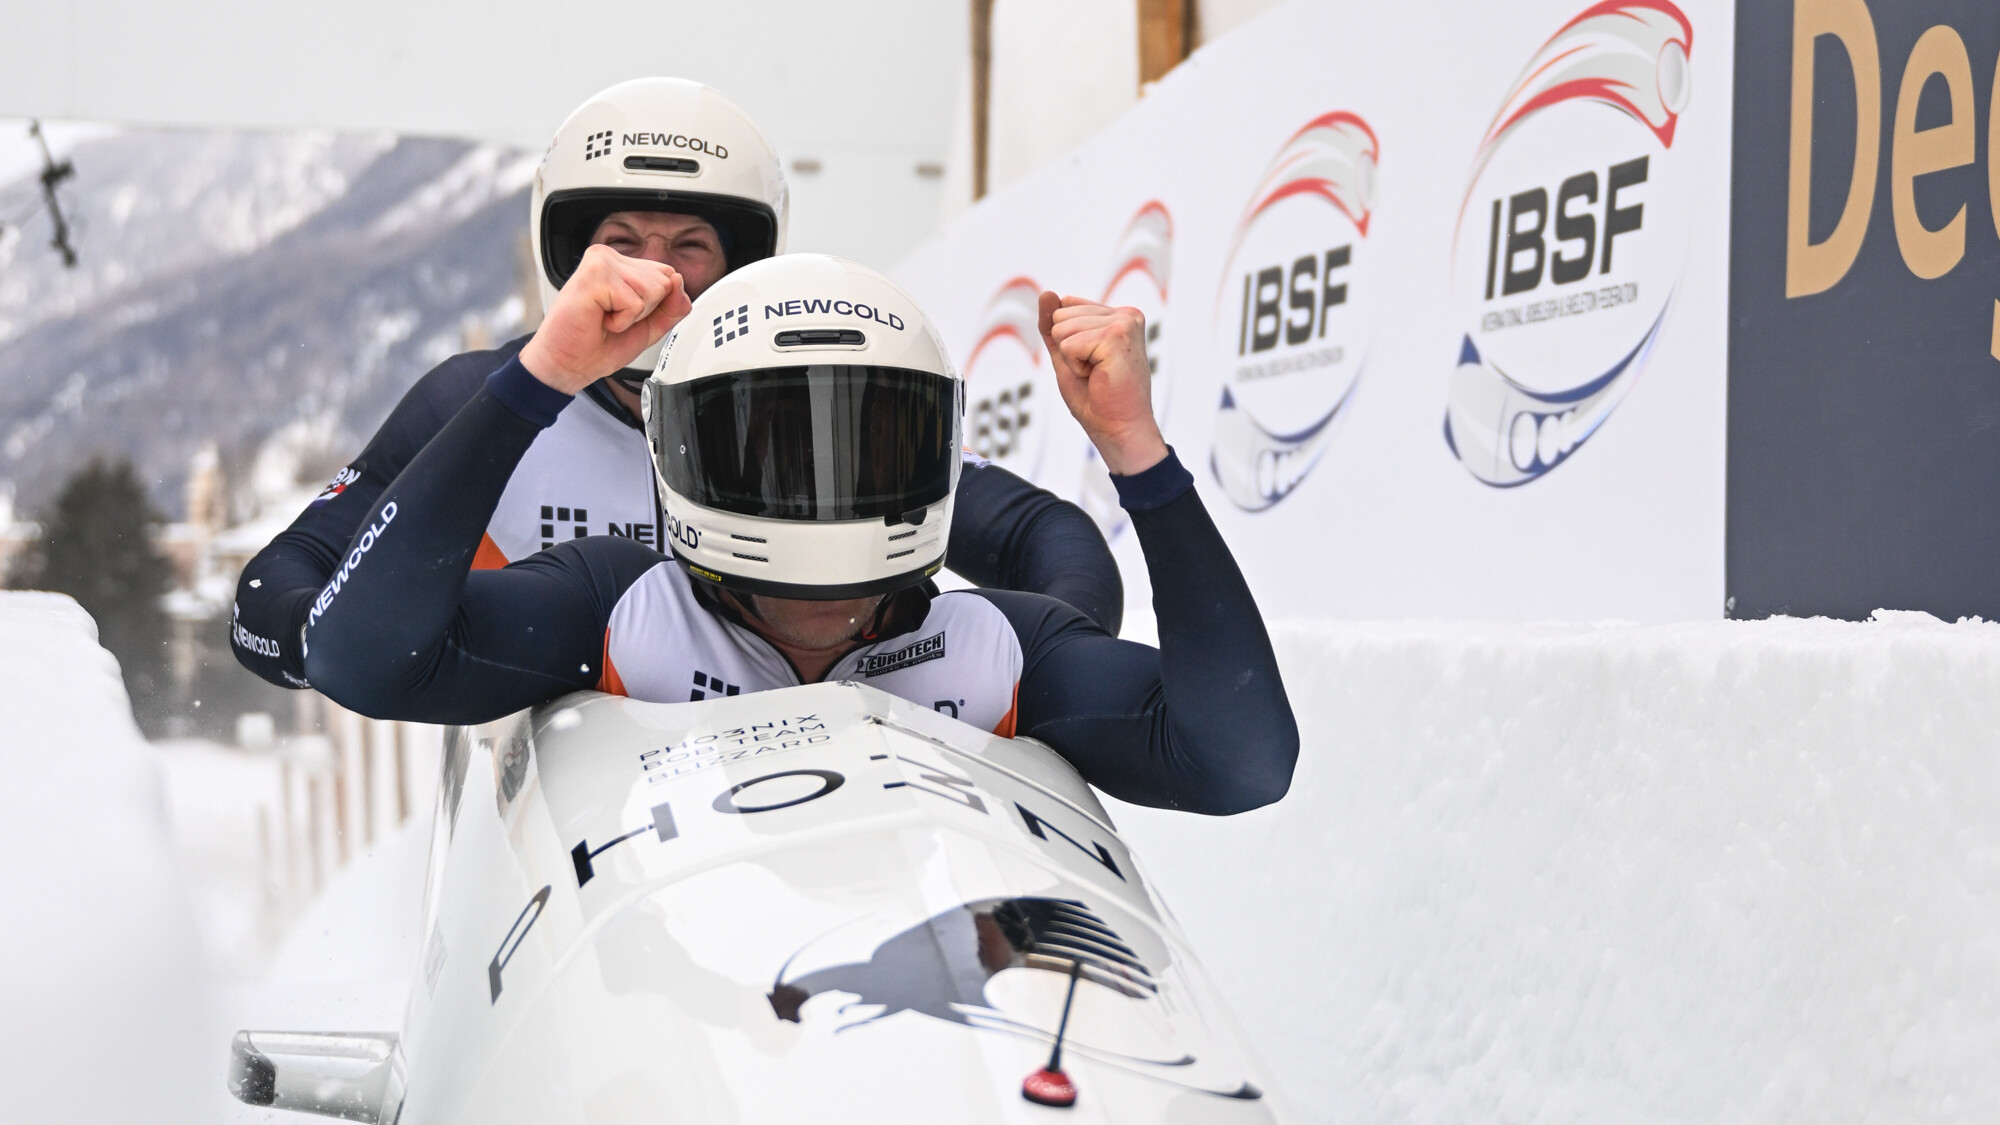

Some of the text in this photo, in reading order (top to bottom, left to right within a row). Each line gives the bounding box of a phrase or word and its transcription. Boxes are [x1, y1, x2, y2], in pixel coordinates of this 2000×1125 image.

[622, 131, 729, 160] NEWCOLD
[1785, 0, 2000, 365] De
[1484, 155, 1650, 300] IBSF
[765, 298, 905, 331] NEWCOLD
[1239, 243, 1351, 356] IBSF
[309, 501, 398, 627] NEWCOLD
[239, 623, 281, 657] NEWCOLD
[868, 635, 942, 670] EUROTECH
[643, 723, 825, 771] BOB TEAM
[648, 735, 830, 783] BLIZZARD
